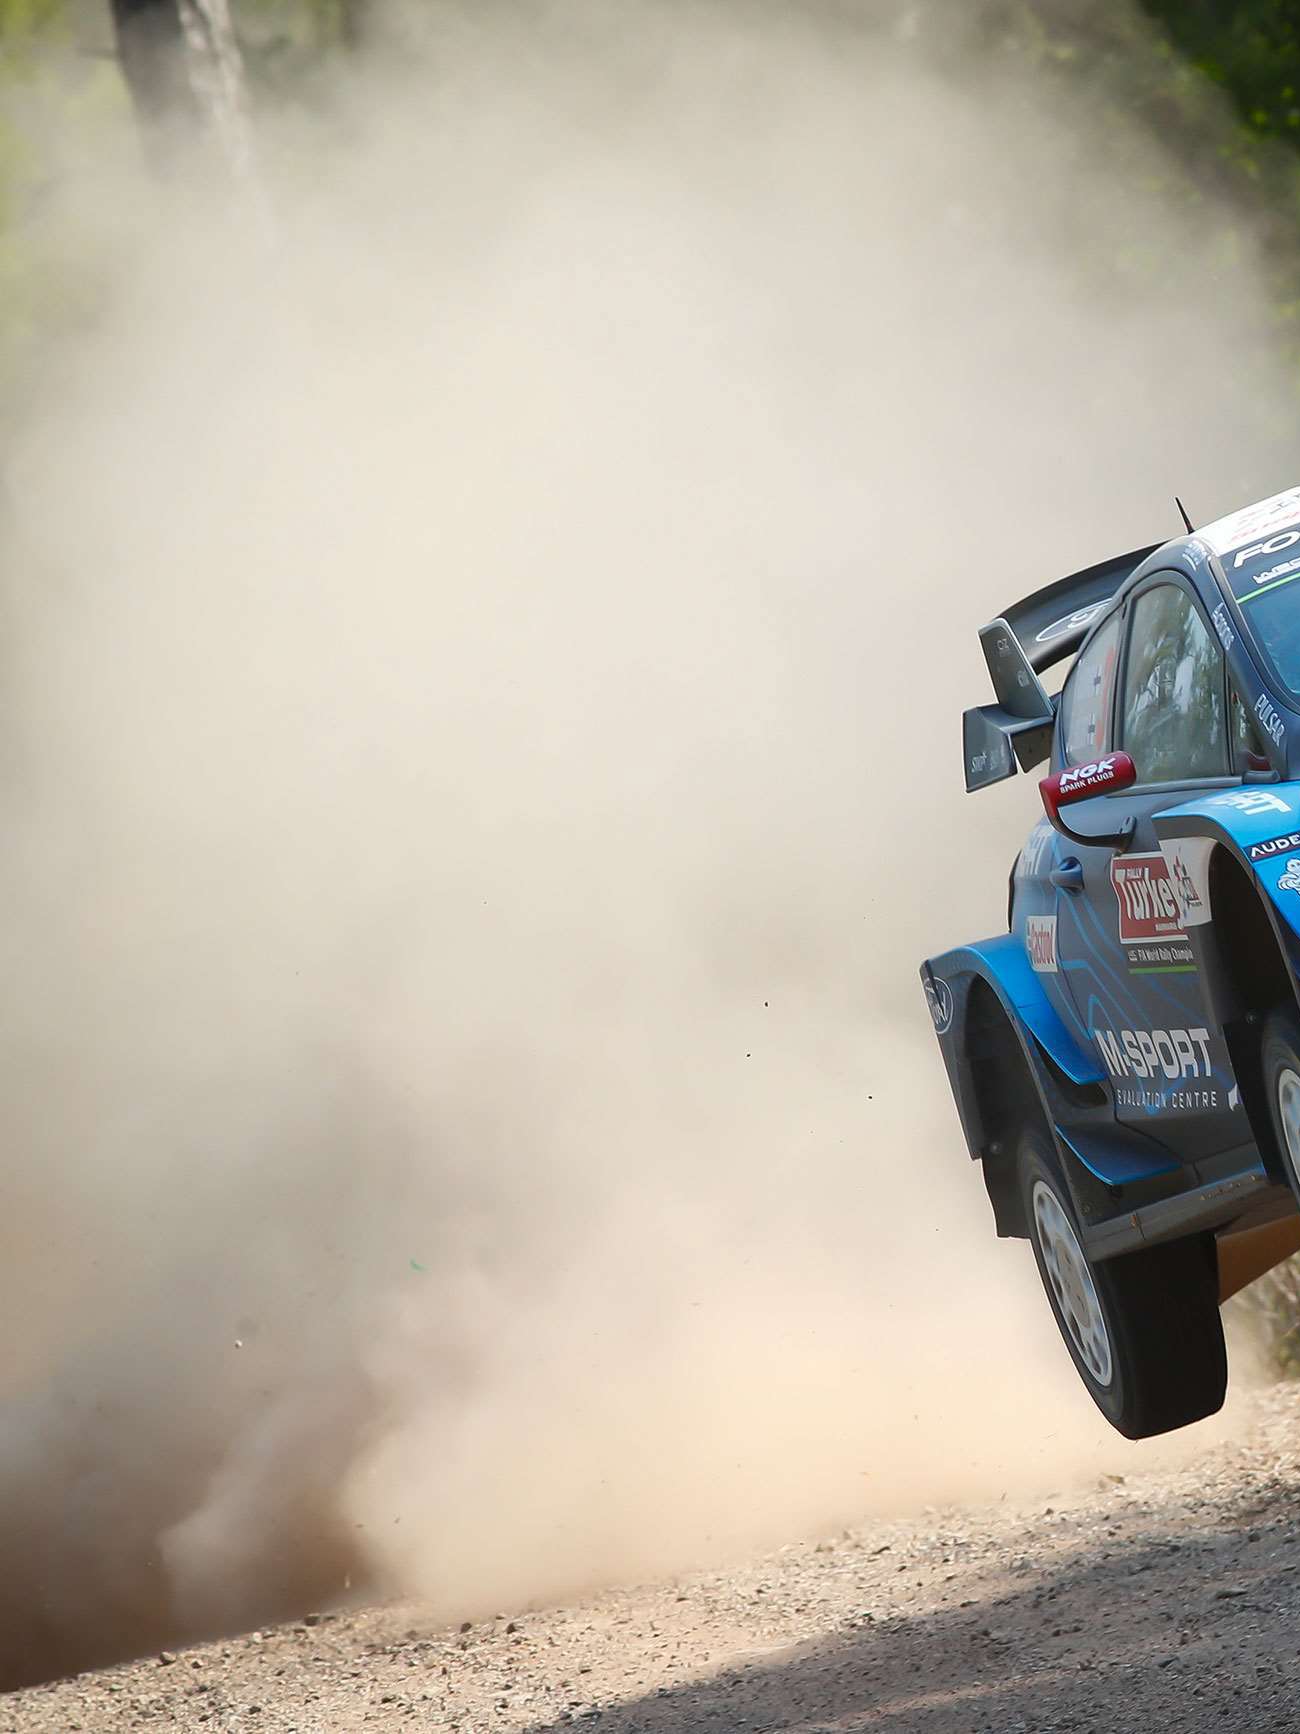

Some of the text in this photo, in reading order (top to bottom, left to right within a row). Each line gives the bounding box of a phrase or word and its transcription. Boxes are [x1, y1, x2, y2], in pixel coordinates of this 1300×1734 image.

[1060, 757, 1116, 786] NGK
[1095, 1028, 1212, 1079] M-SPORT
[1171, 1090, 1217, 1109] CENTRE
